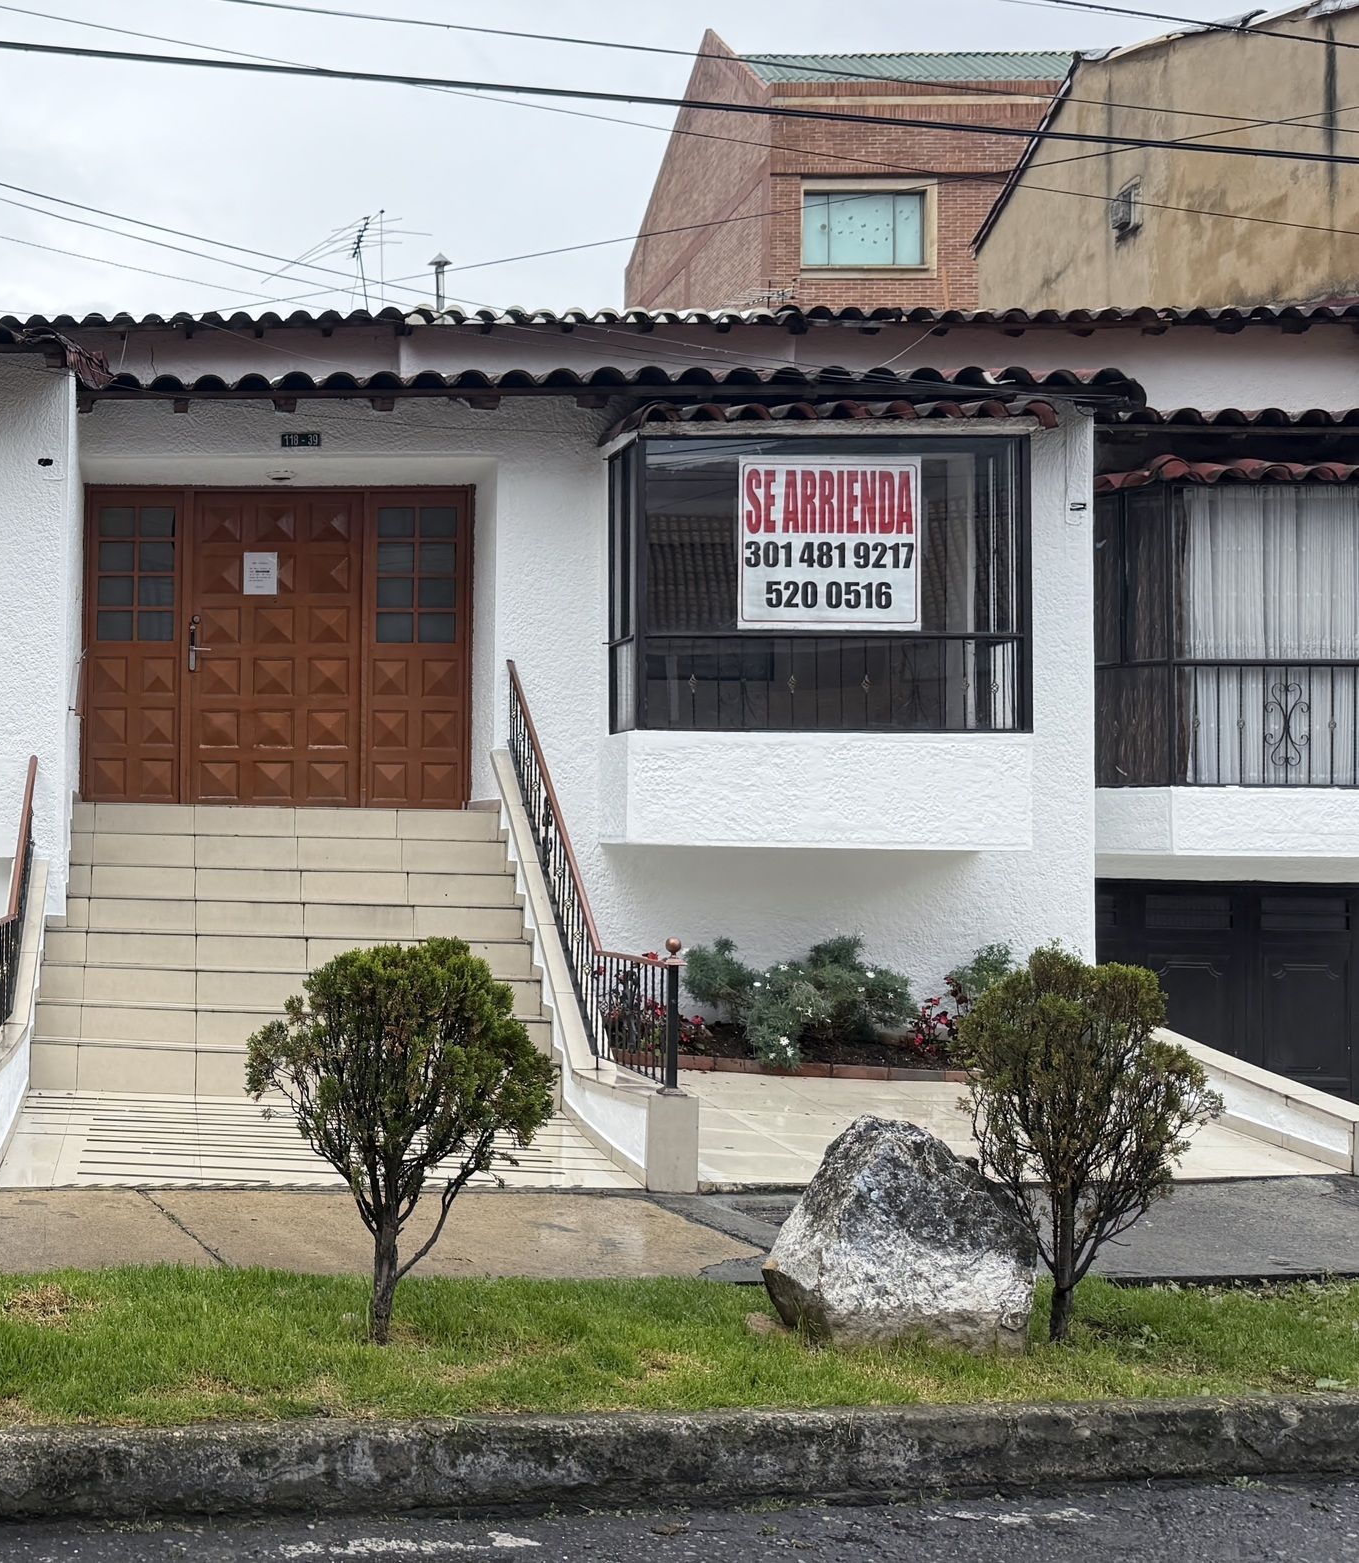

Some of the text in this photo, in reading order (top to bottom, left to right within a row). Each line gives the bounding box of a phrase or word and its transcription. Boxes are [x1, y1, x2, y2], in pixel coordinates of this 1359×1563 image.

[284, 434, 299, 446] 118
[307, 434, 318, 446] 39
[746, 468, 914, 535] SE ARRIENDA
[745, 541, 914, 569] 301 481 9217
[765, 581, 892, 609] 520 0516
